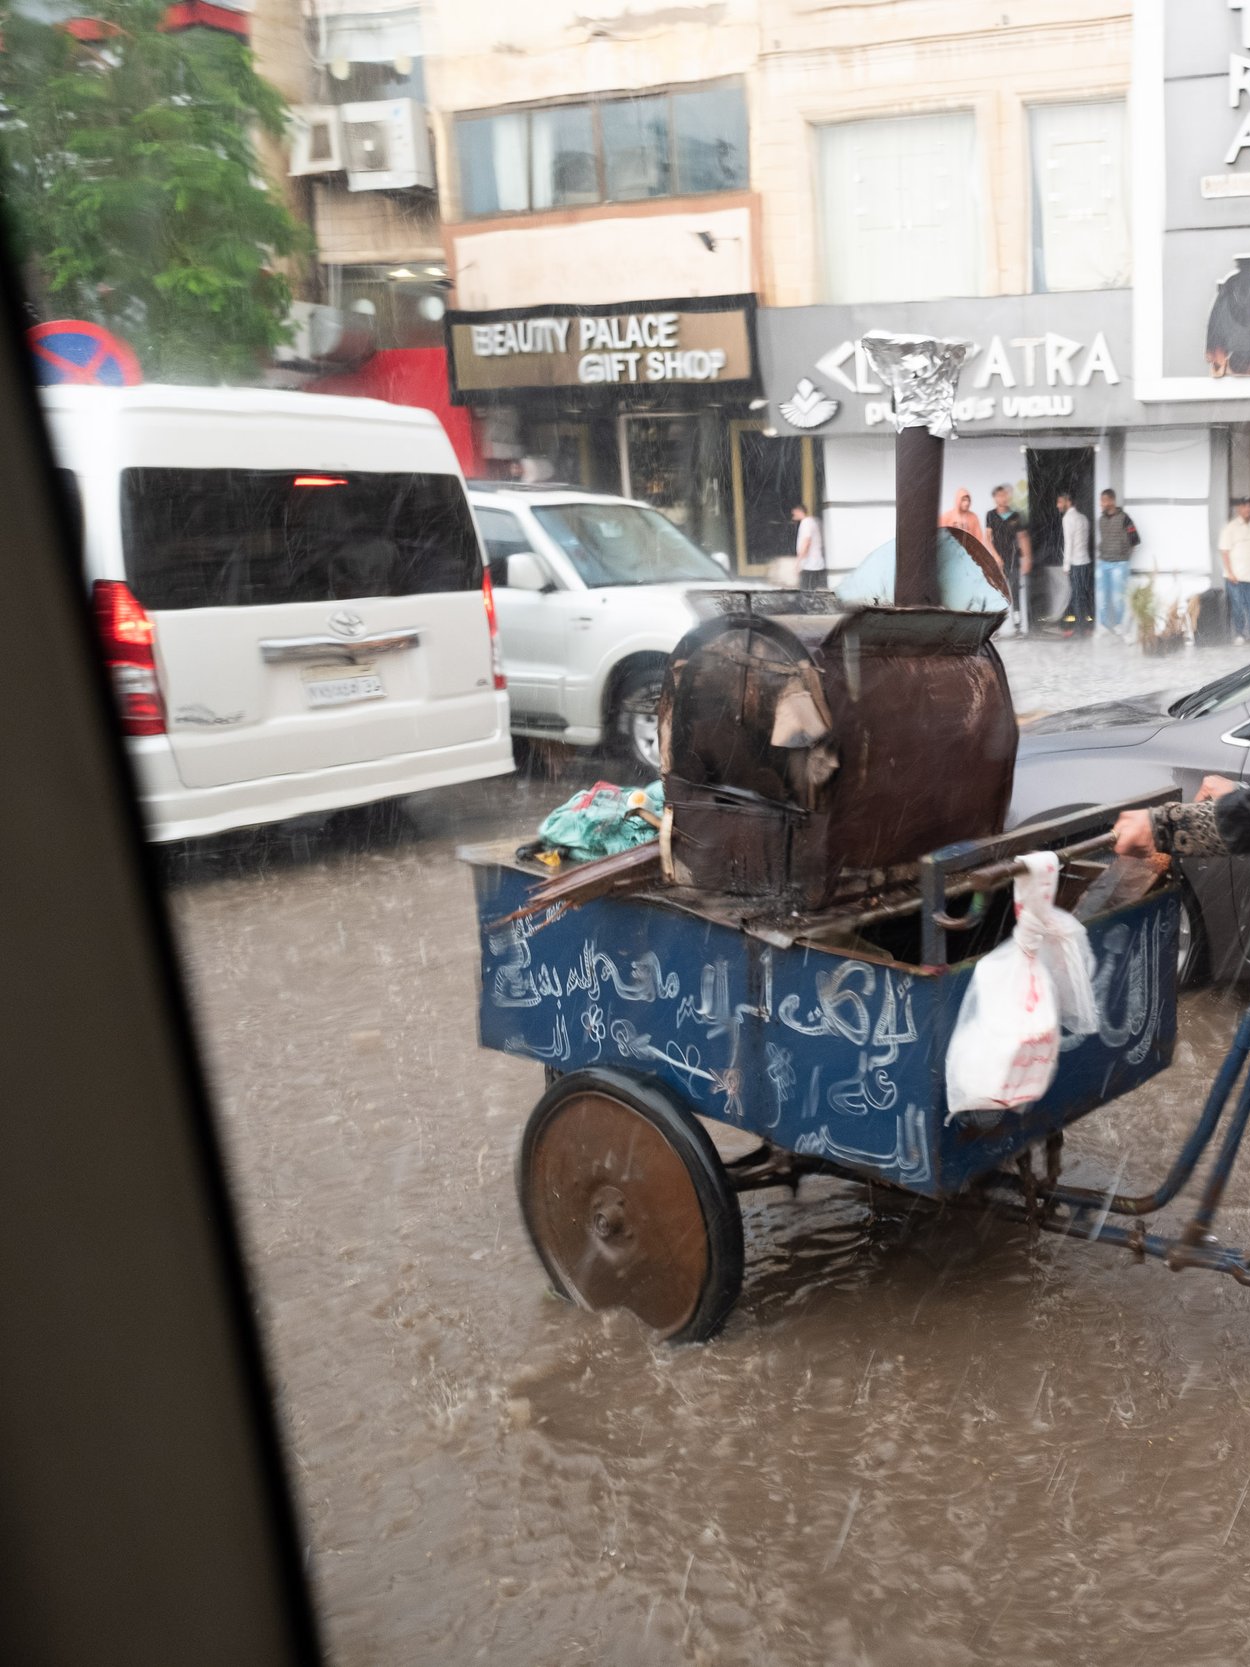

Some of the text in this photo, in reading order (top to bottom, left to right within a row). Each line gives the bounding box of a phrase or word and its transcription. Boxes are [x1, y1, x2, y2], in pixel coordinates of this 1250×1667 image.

[472, 312, 679, 357] BEAUTY PALACE
[577, 348, 727, 384] GIFT SHOP
[814, 332, 1121, 394] CLATRA
